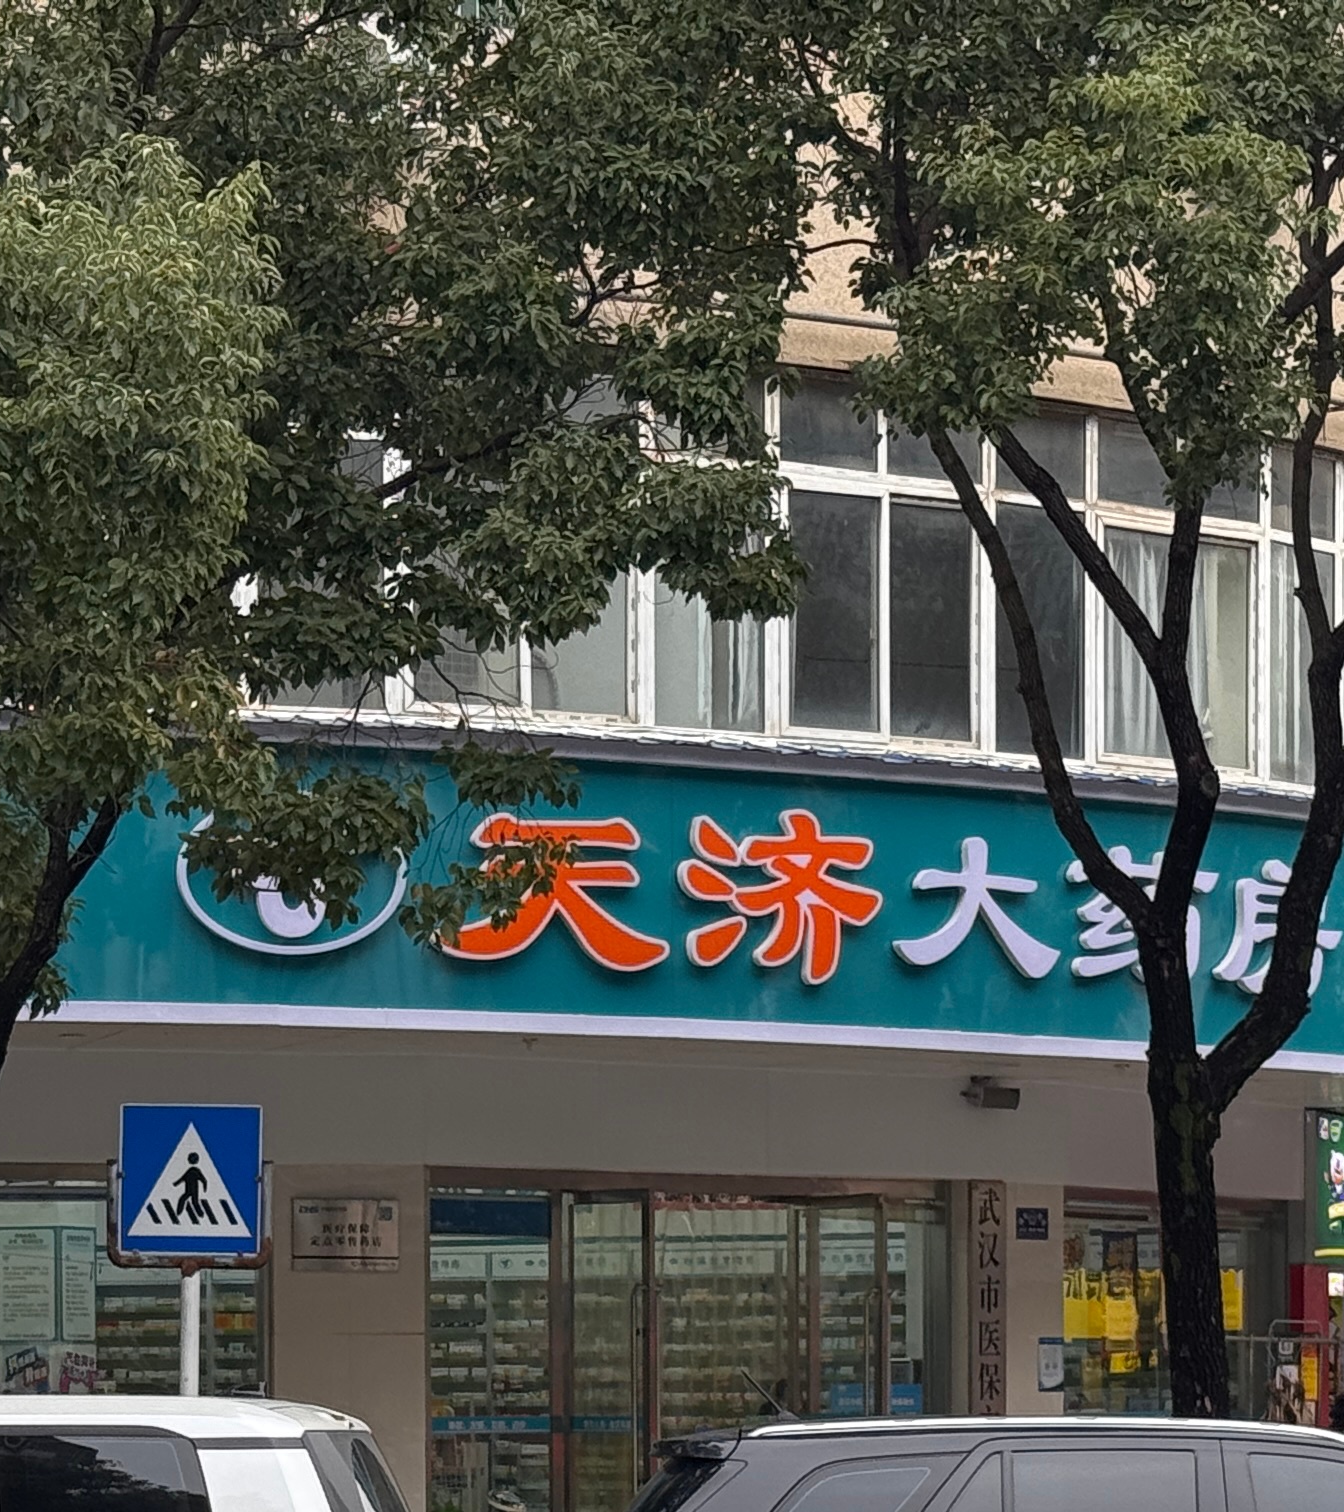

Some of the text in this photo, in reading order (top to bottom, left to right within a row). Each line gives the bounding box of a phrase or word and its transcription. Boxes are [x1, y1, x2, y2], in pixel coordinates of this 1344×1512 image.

[977, 1189, 1002, 1415] 武汉市医保
